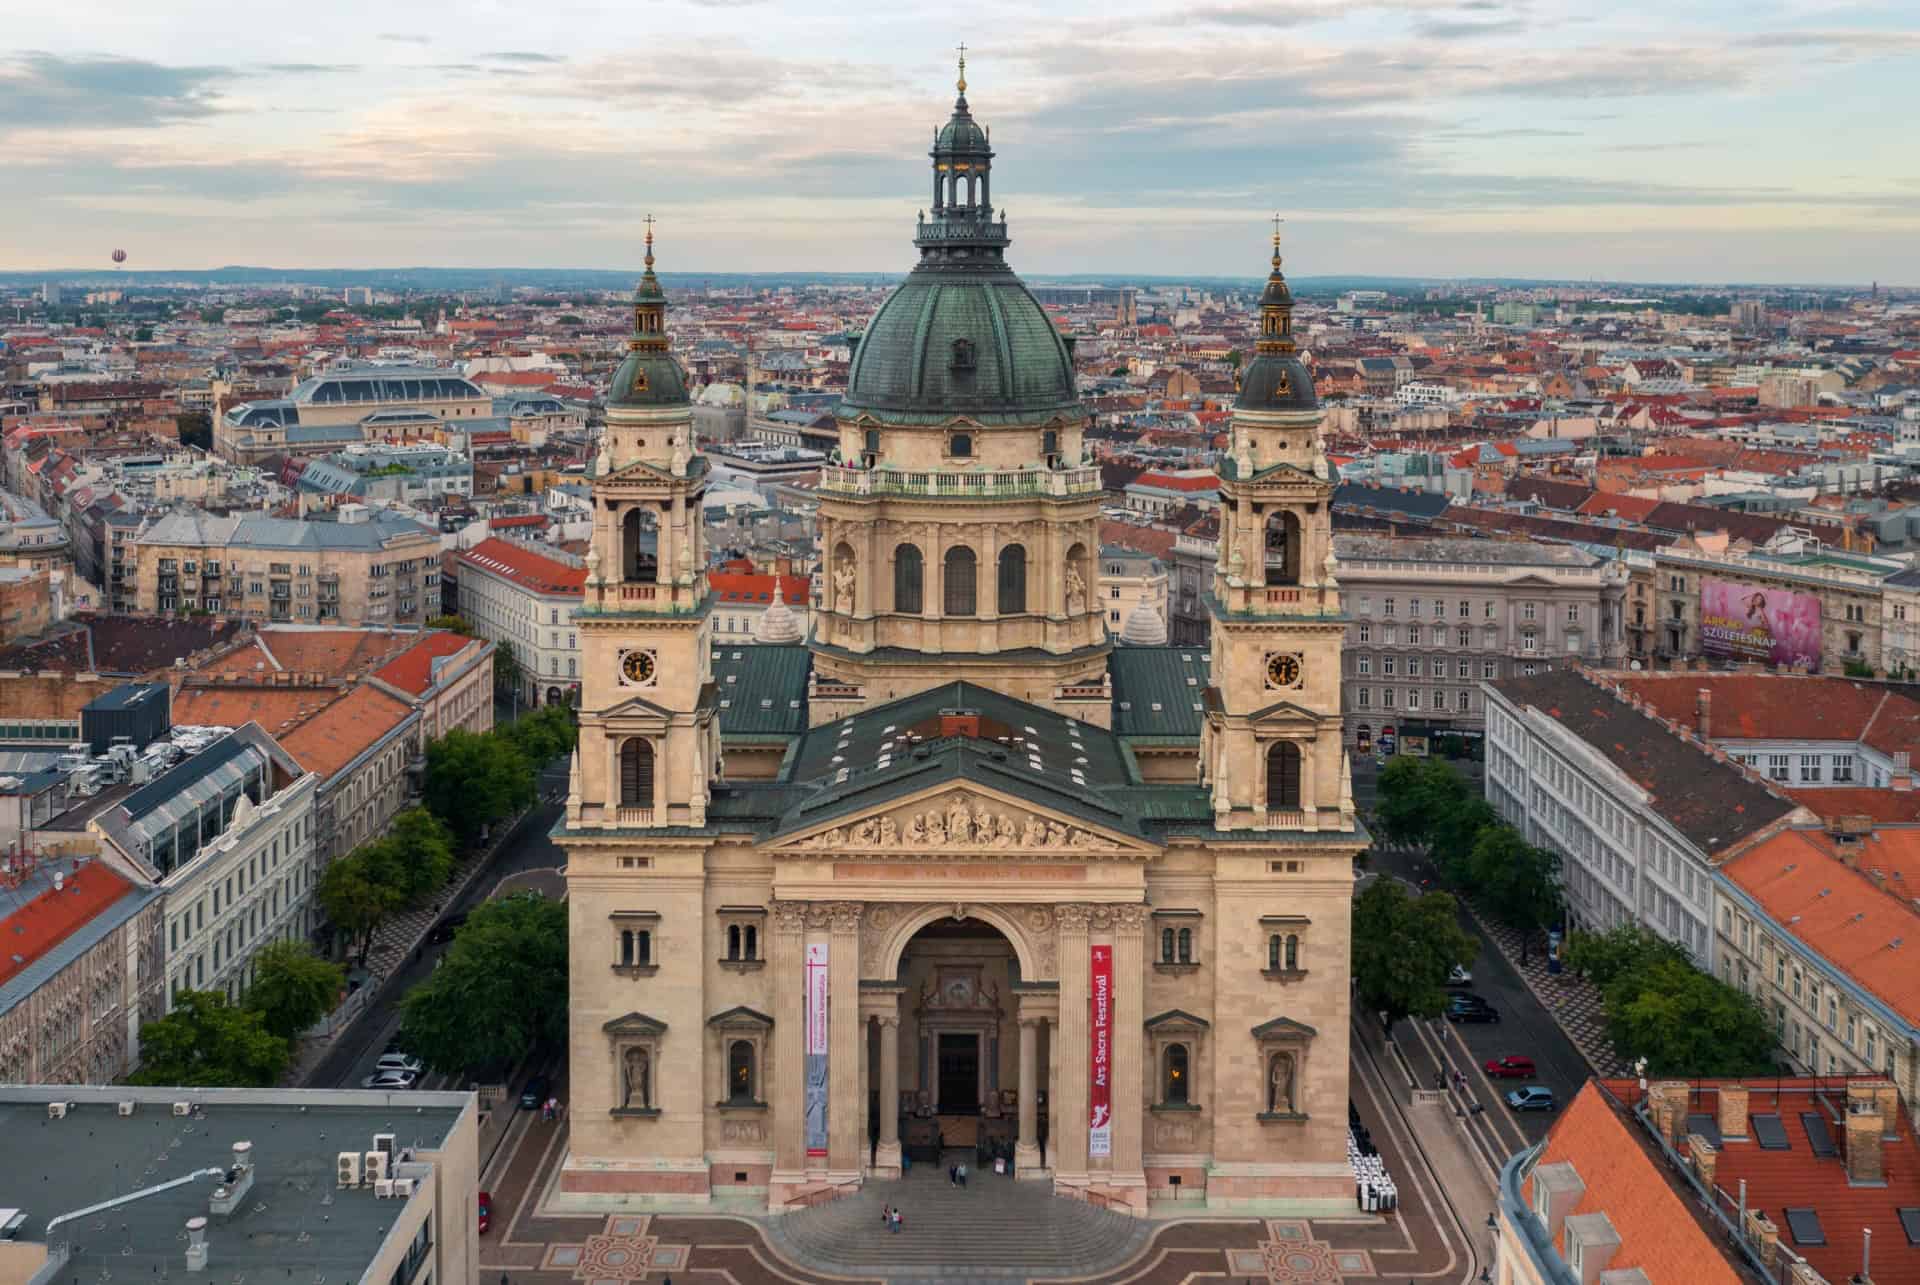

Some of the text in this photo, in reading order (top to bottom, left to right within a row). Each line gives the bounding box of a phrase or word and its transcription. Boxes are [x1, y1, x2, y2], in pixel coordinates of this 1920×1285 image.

[1095, 974, 1106, 1086] Ars Sacra Fesztivál
